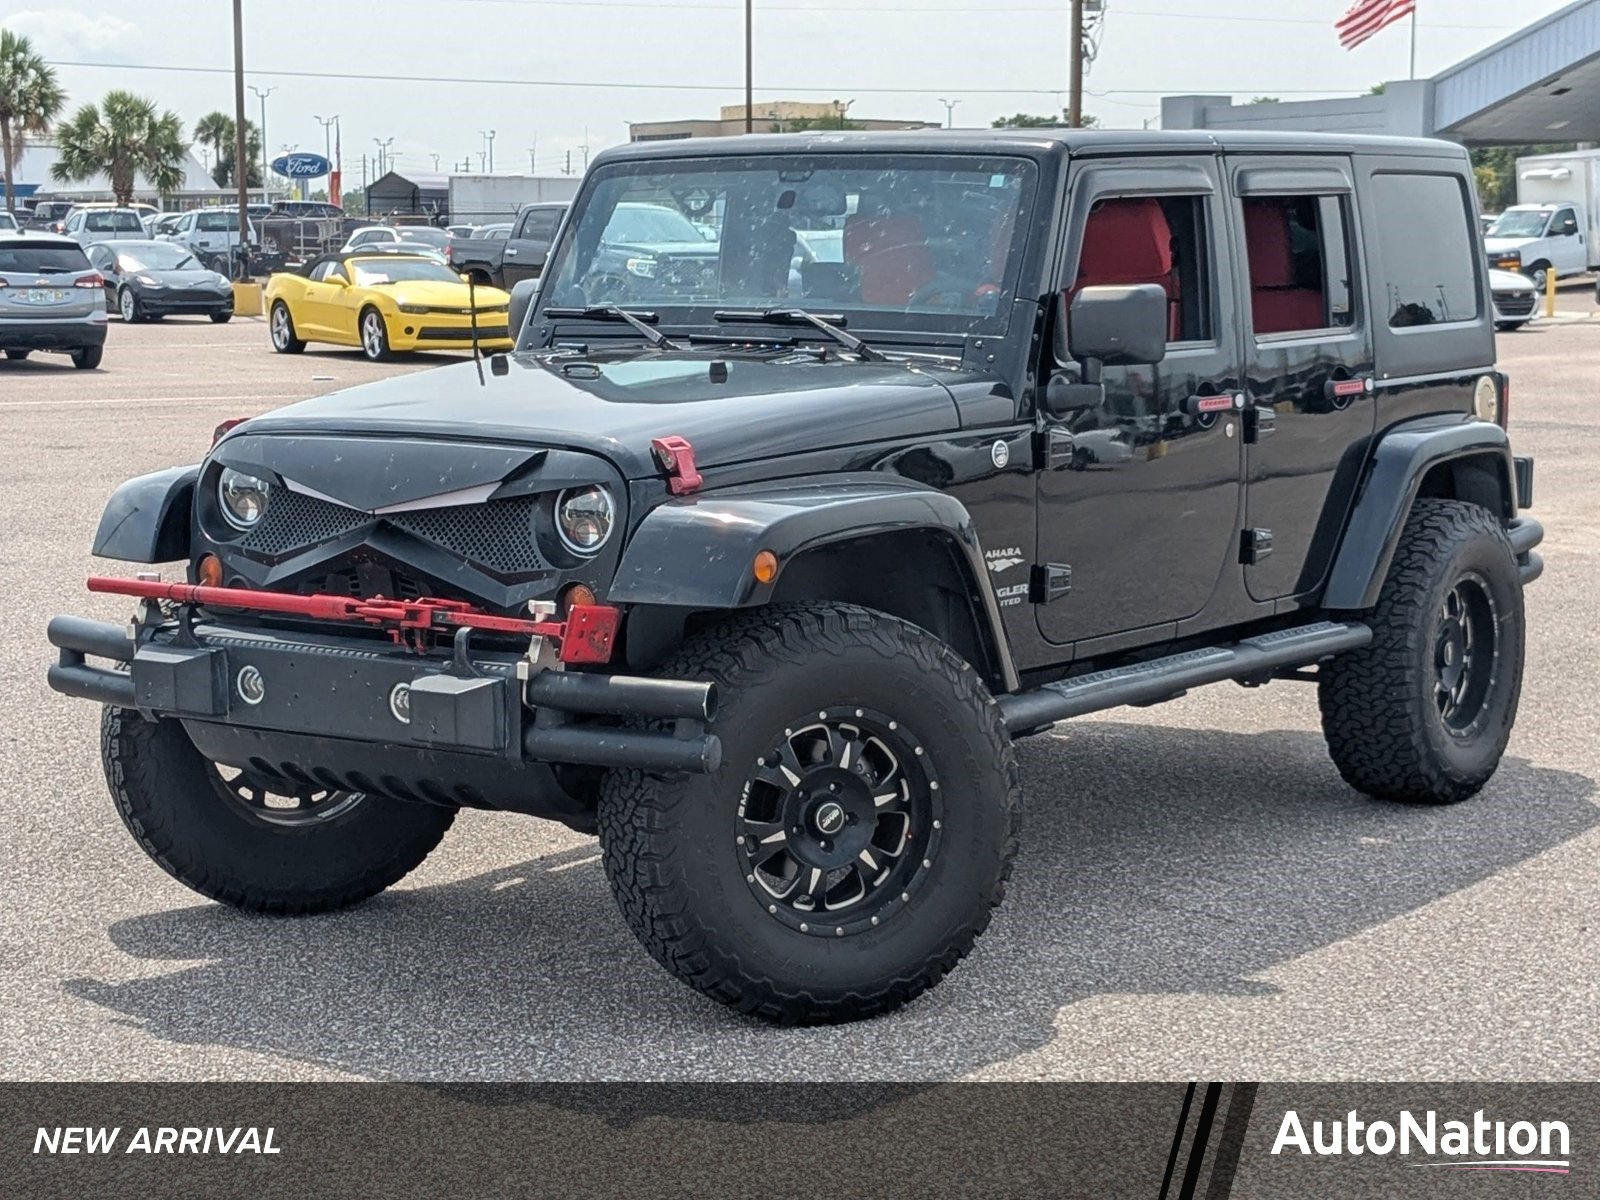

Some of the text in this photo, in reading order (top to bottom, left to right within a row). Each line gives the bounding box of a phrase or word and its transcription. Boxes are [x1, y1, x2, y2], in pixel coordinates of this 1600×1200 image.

[285, 158, 320, 174] Ford
[985, 547, 1022, 559] AHARA
[997, 583, 1029, 597] GLER
